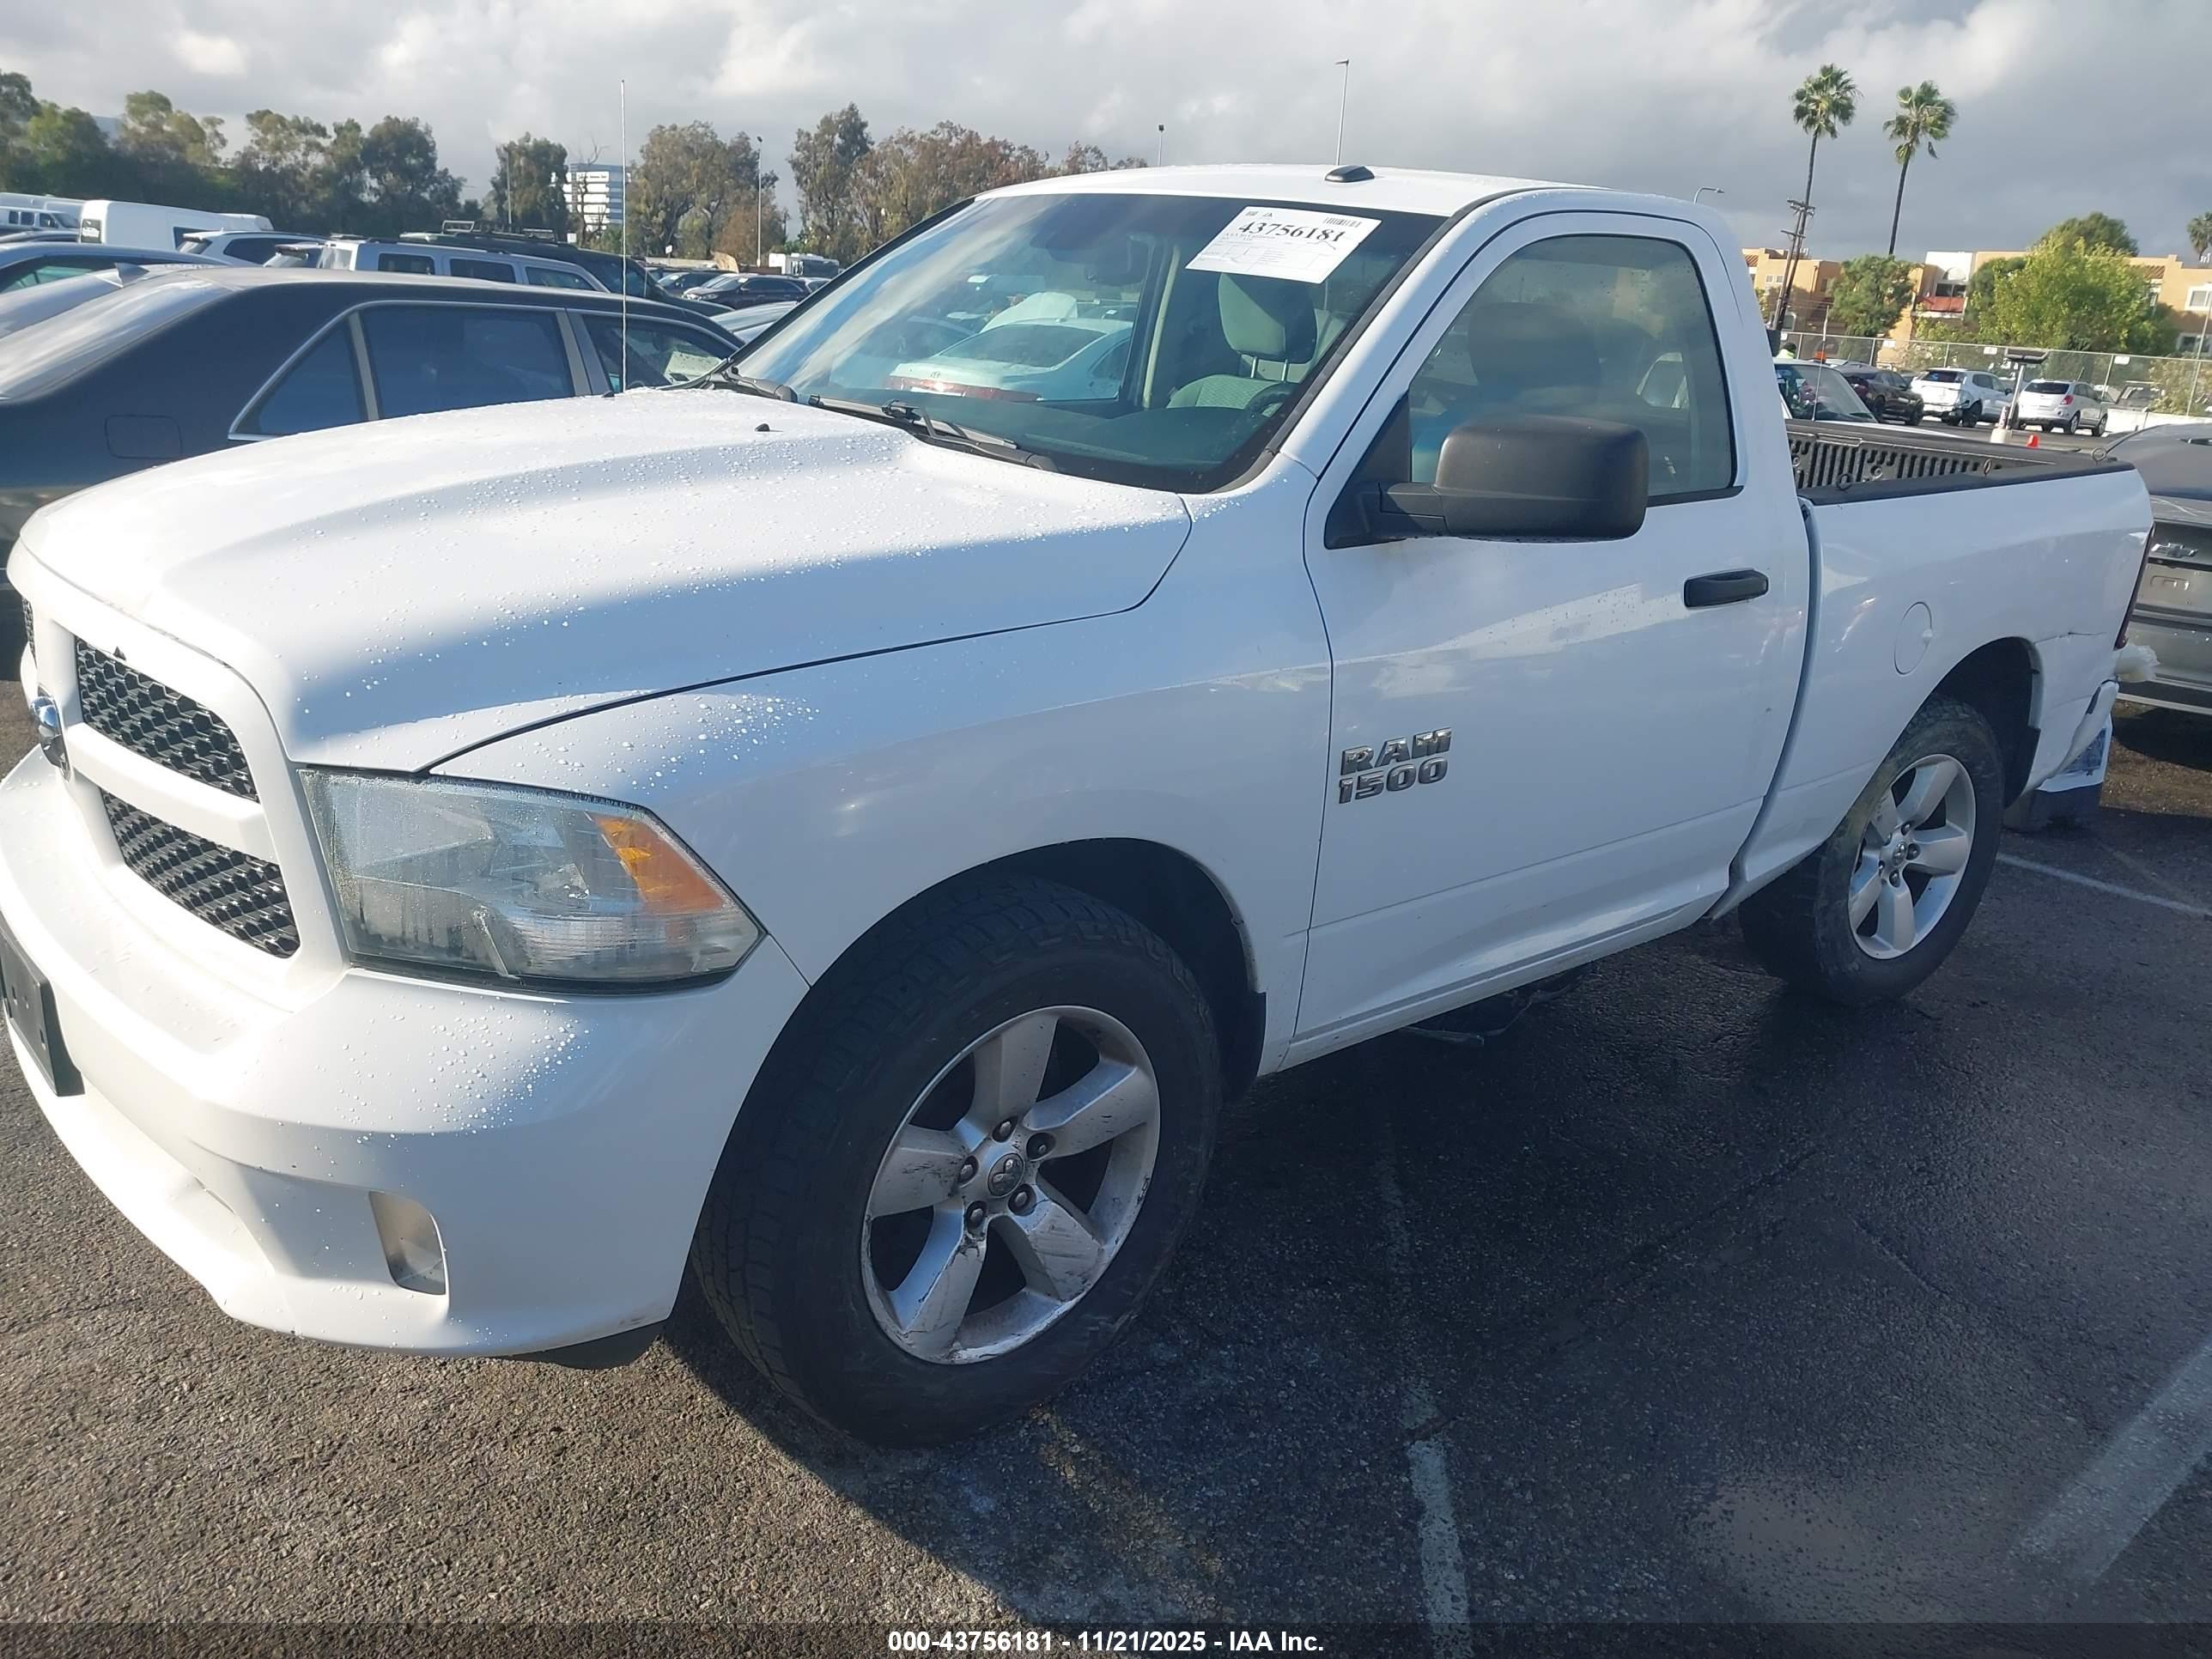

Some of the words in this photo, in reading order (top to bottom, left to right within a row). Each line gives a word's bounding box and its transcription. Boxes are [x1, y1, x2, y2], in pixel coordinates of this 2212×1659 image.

[1238, 221, 1346, 242] 43756181
[1340, 726, 1452, 775] RAM
[1338, 757, 1449, 805] 1500
